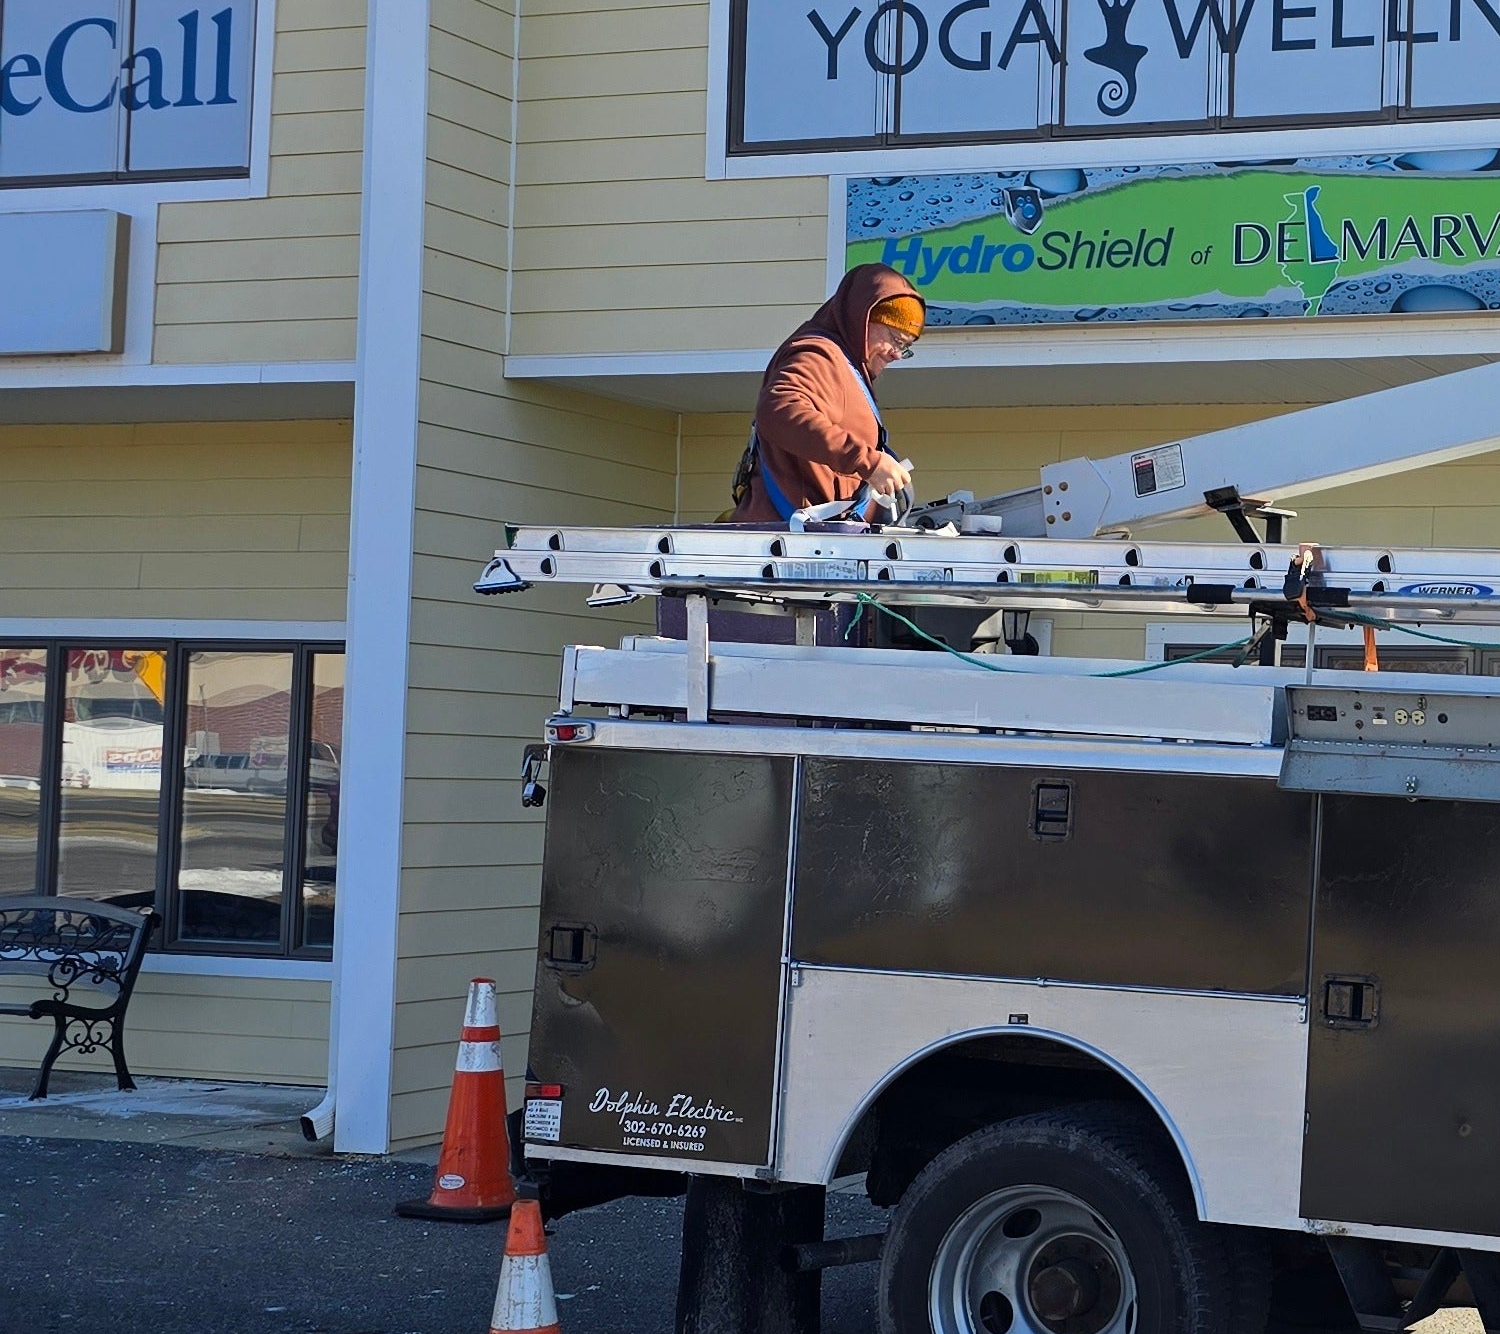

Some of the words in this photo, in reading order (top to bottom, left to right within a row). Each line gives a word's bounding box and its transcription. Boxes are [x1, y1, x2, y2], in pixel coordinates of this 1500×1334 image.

[0, 7, 237, 118] eCall
[1190, 245, 1213, 266] of
[1418, 586, 1474, 595] WERNER
[588, 1087, 660, 1125] Dolphin
[665, 1093, 735, 1122] Electric
[623, 1120, 707, 1139] 302-670-6269
[622, 1136, 661, 1149] LICENSED
[662, 1140, 669, 1149] &
[670, 1140, 705, 1152] INSURED
